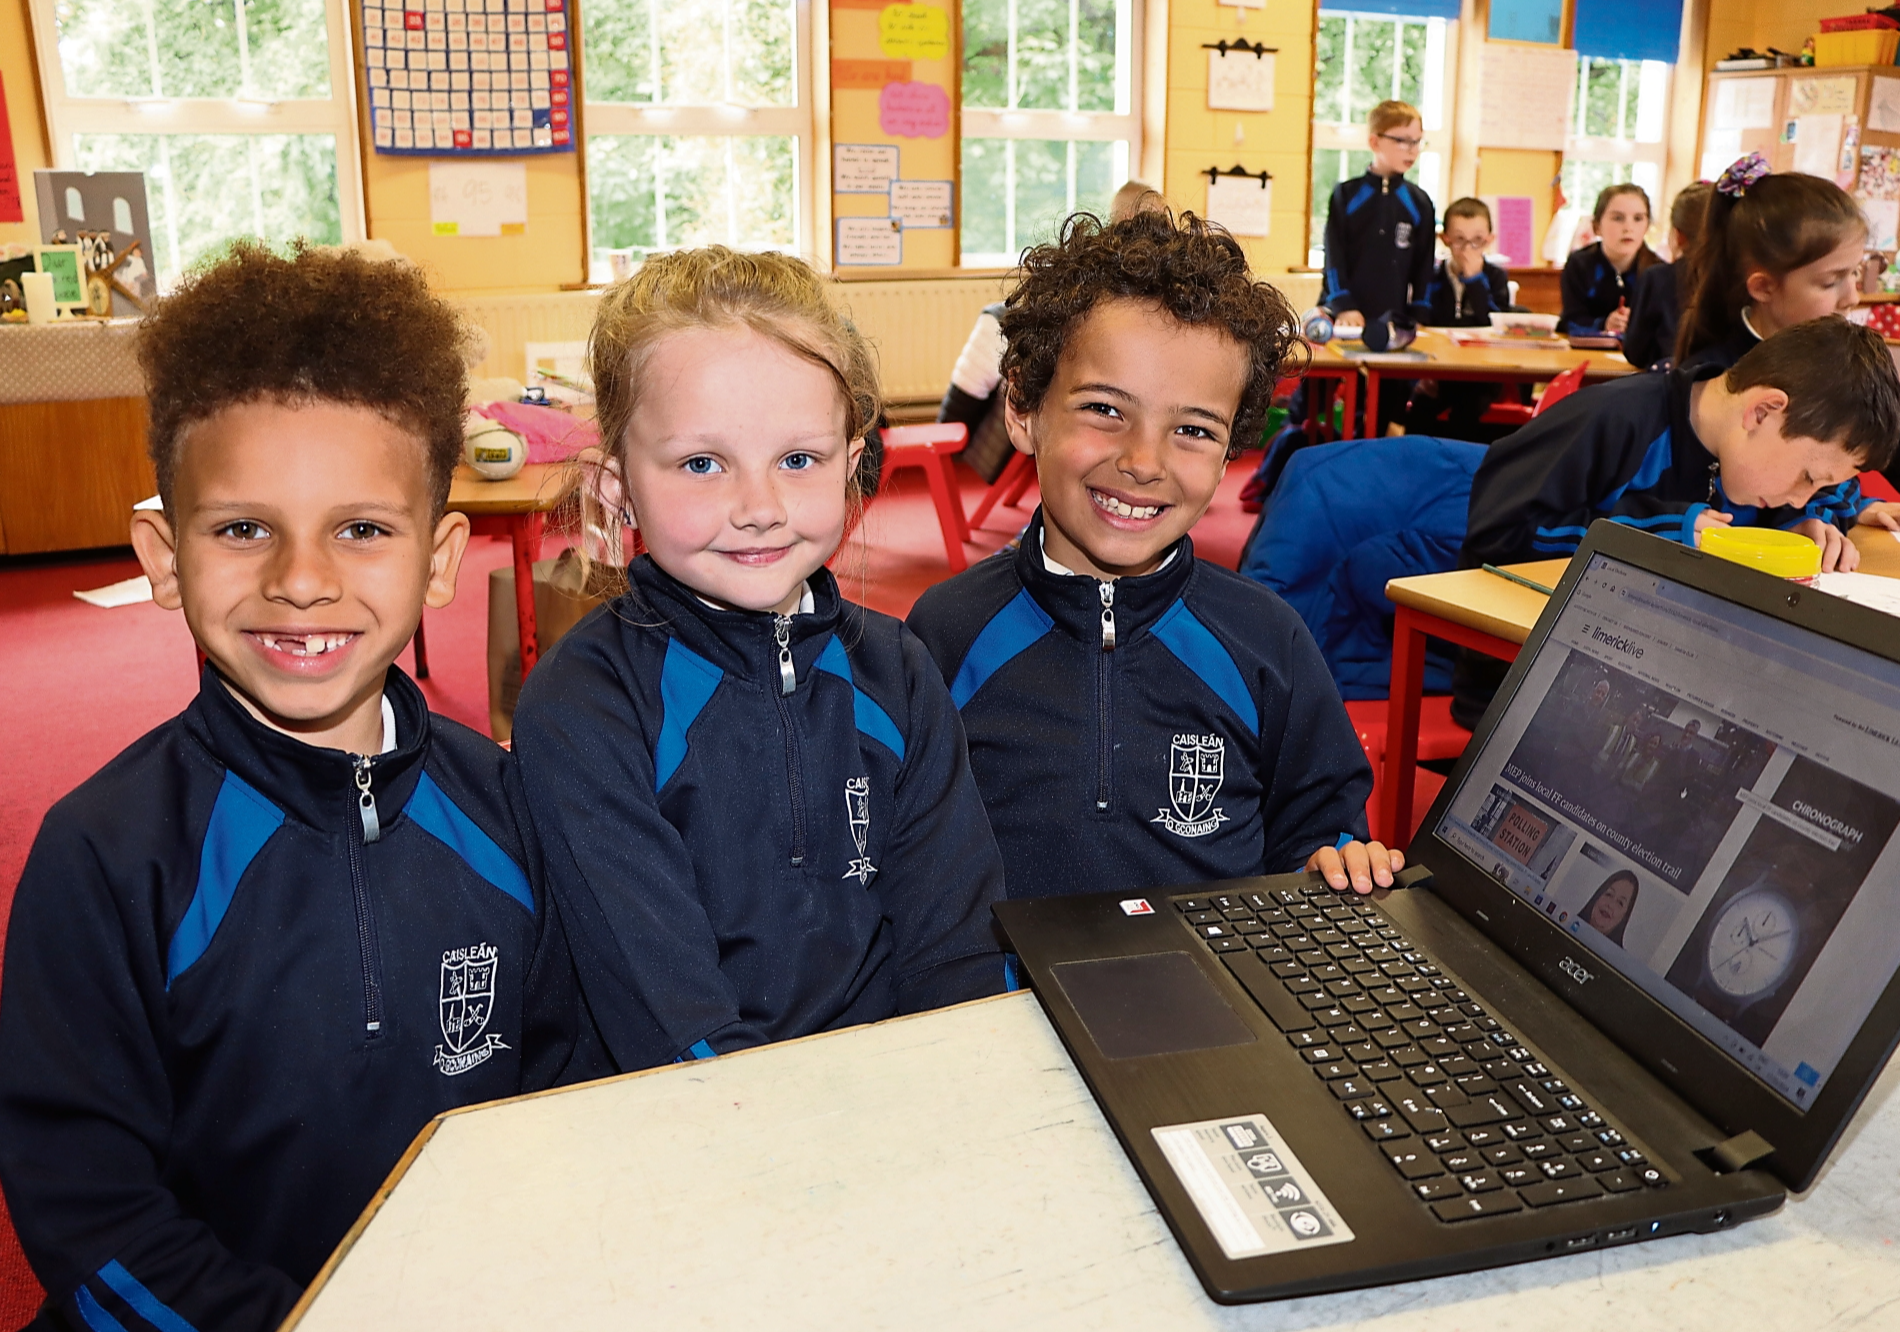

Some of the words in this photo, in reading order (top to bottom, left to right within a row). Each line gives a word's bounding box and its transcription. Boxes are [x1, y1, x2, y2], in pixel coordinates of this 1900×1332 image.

[1591, 626, 1644, 659] limericklive
[1172, 733, 1224, 748] CAISLEÁN
[1505, 763, 1521, 778] MEP
[1519, 773, 1536, 788] joins
[1535, 781, 1551, 798] local
[1551, 791, 1563, 804] FF
[1560, 798, 1596, 827] candidates
[1596, 822, 1607, 833] on
[1607, 827, 1632, 851] county
[1632, 842, 1666, 869] election
[1663, 860, 1682, 879] trail
[1508, 813, 1540, 841] POLLING
[1792, 800, 1864, 843] CHRONOGRAPH
[1500, 828, 1531, 858] STATION
[442, 942, 498, 963] CAISLEÁN
[1559, 956, 1594, 985] acer
